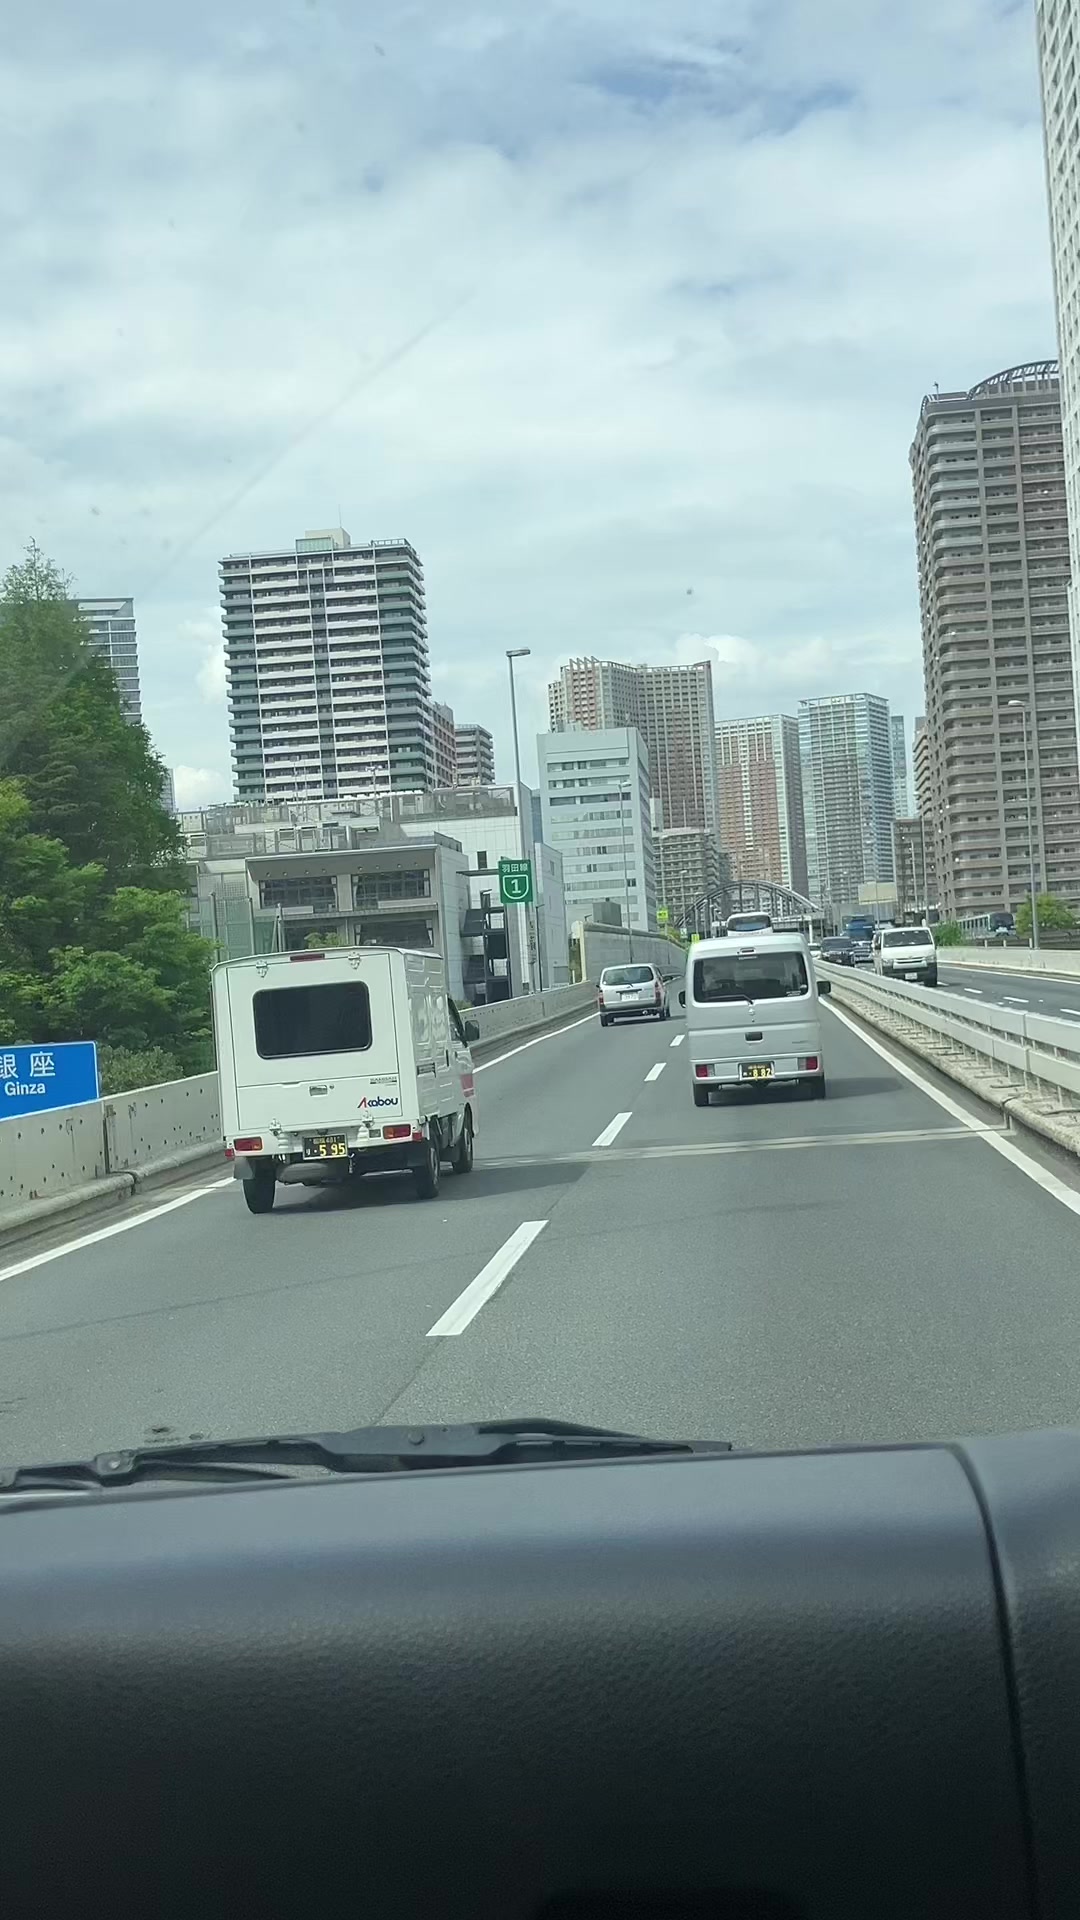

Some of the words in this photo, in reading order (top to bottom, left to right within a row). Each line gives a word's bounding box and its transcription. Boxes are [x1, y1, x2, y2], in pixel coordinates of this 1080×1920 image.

[501, 862, 528, 873] 羽田線
[511, 879, 522, 894] 1
[0, 1051, 56, 1079] 銀座
[4, 1081, 46, 1096] Ginza
